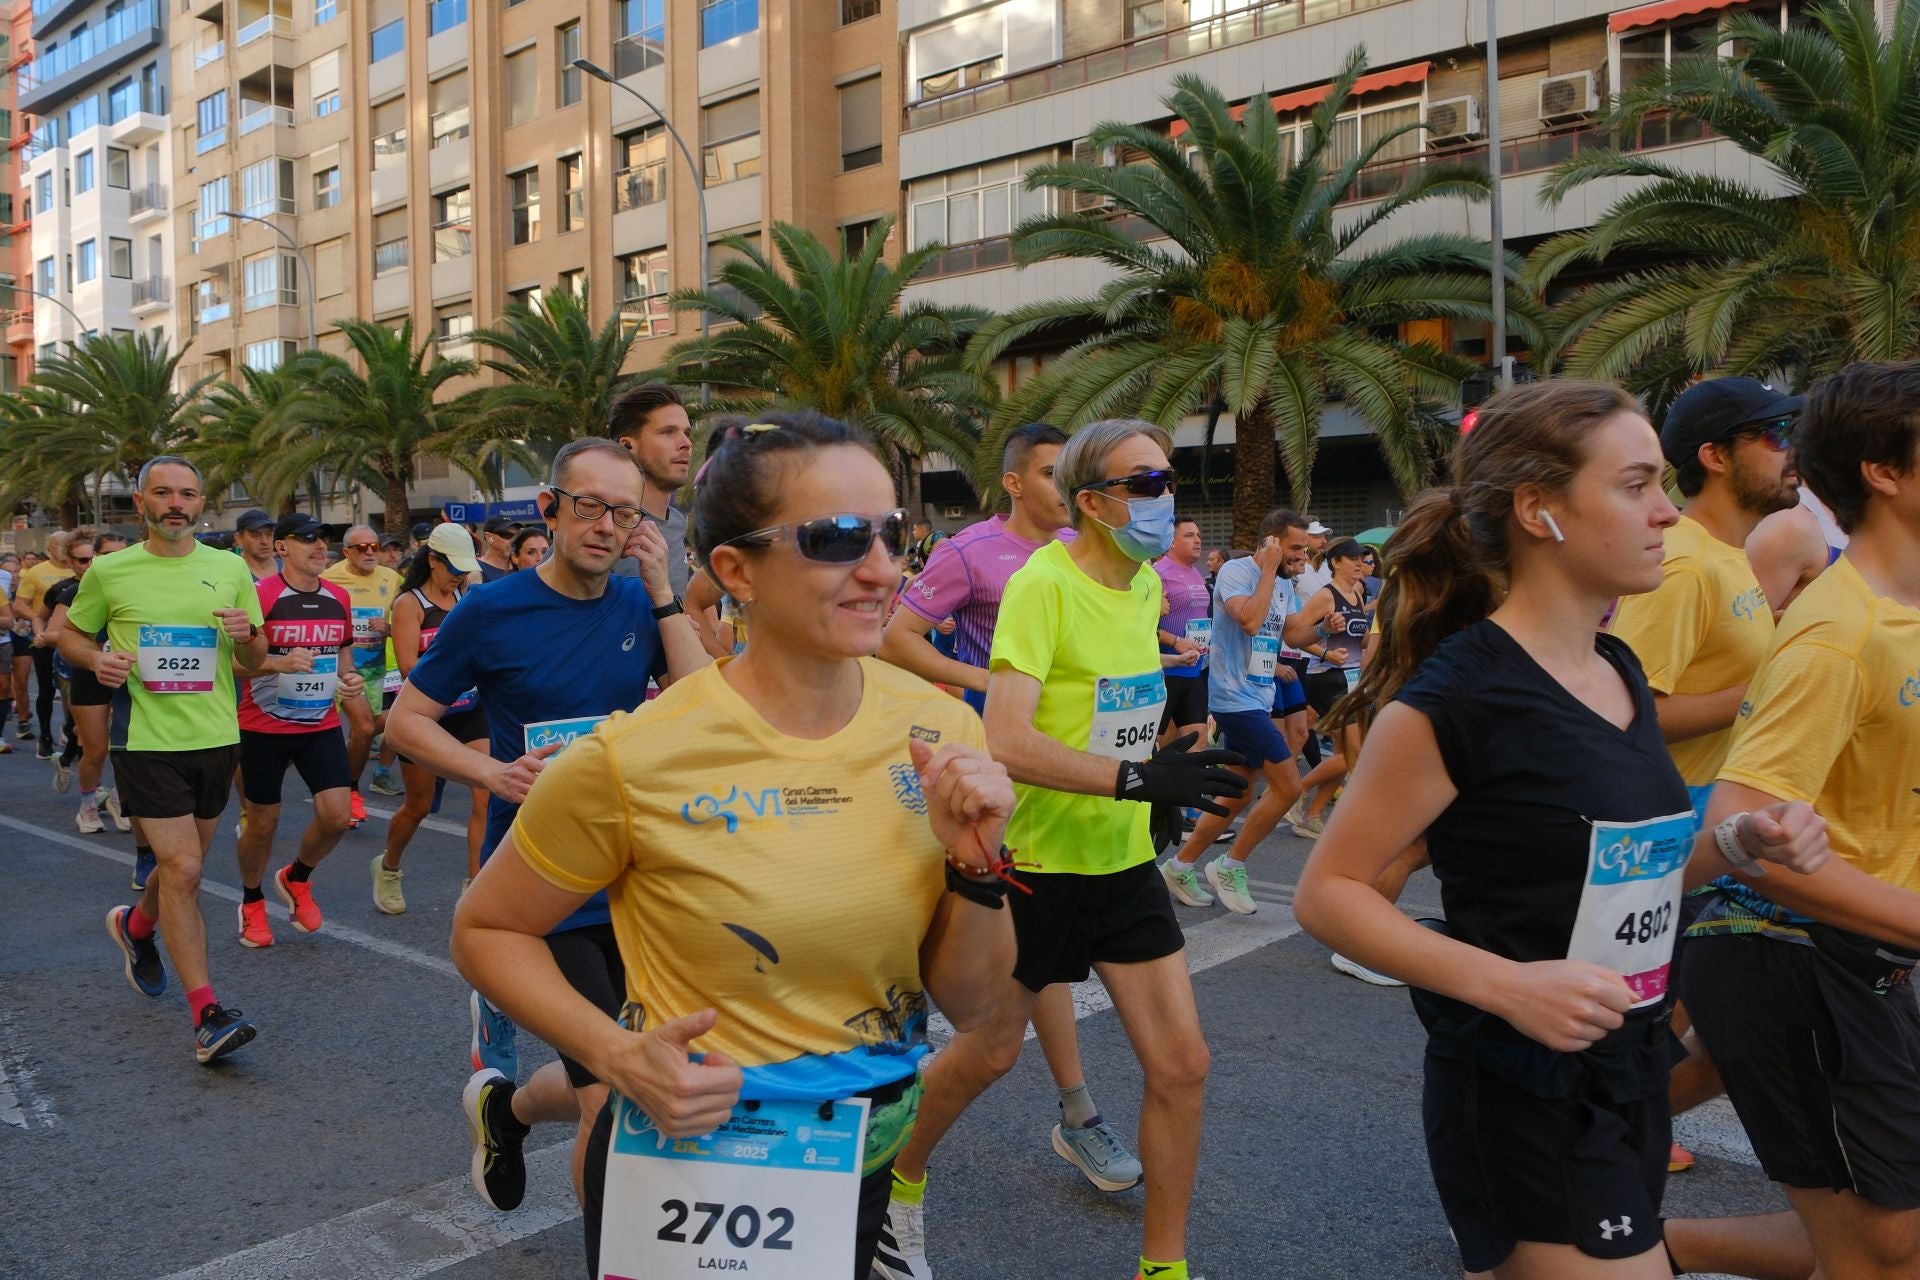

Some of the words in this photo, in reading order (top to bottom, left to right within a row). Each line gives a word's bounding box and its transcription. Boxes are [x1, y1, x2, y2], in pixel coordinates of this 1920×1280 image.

[157, 657, 200, 670] 2622
[295, 682, 324, 692] 3741
[1114, 721, 1155, 749] 5045
[743, 788, 784, 817] VI
[783, 787, 806, 797] Gran
[1615, 900, 1671, 946] 4802
[733, 1145, 769, 1160] 2025
[657, 1199, 795, 1250] 2702
[698, 1256, 748, 1272] LAURA
